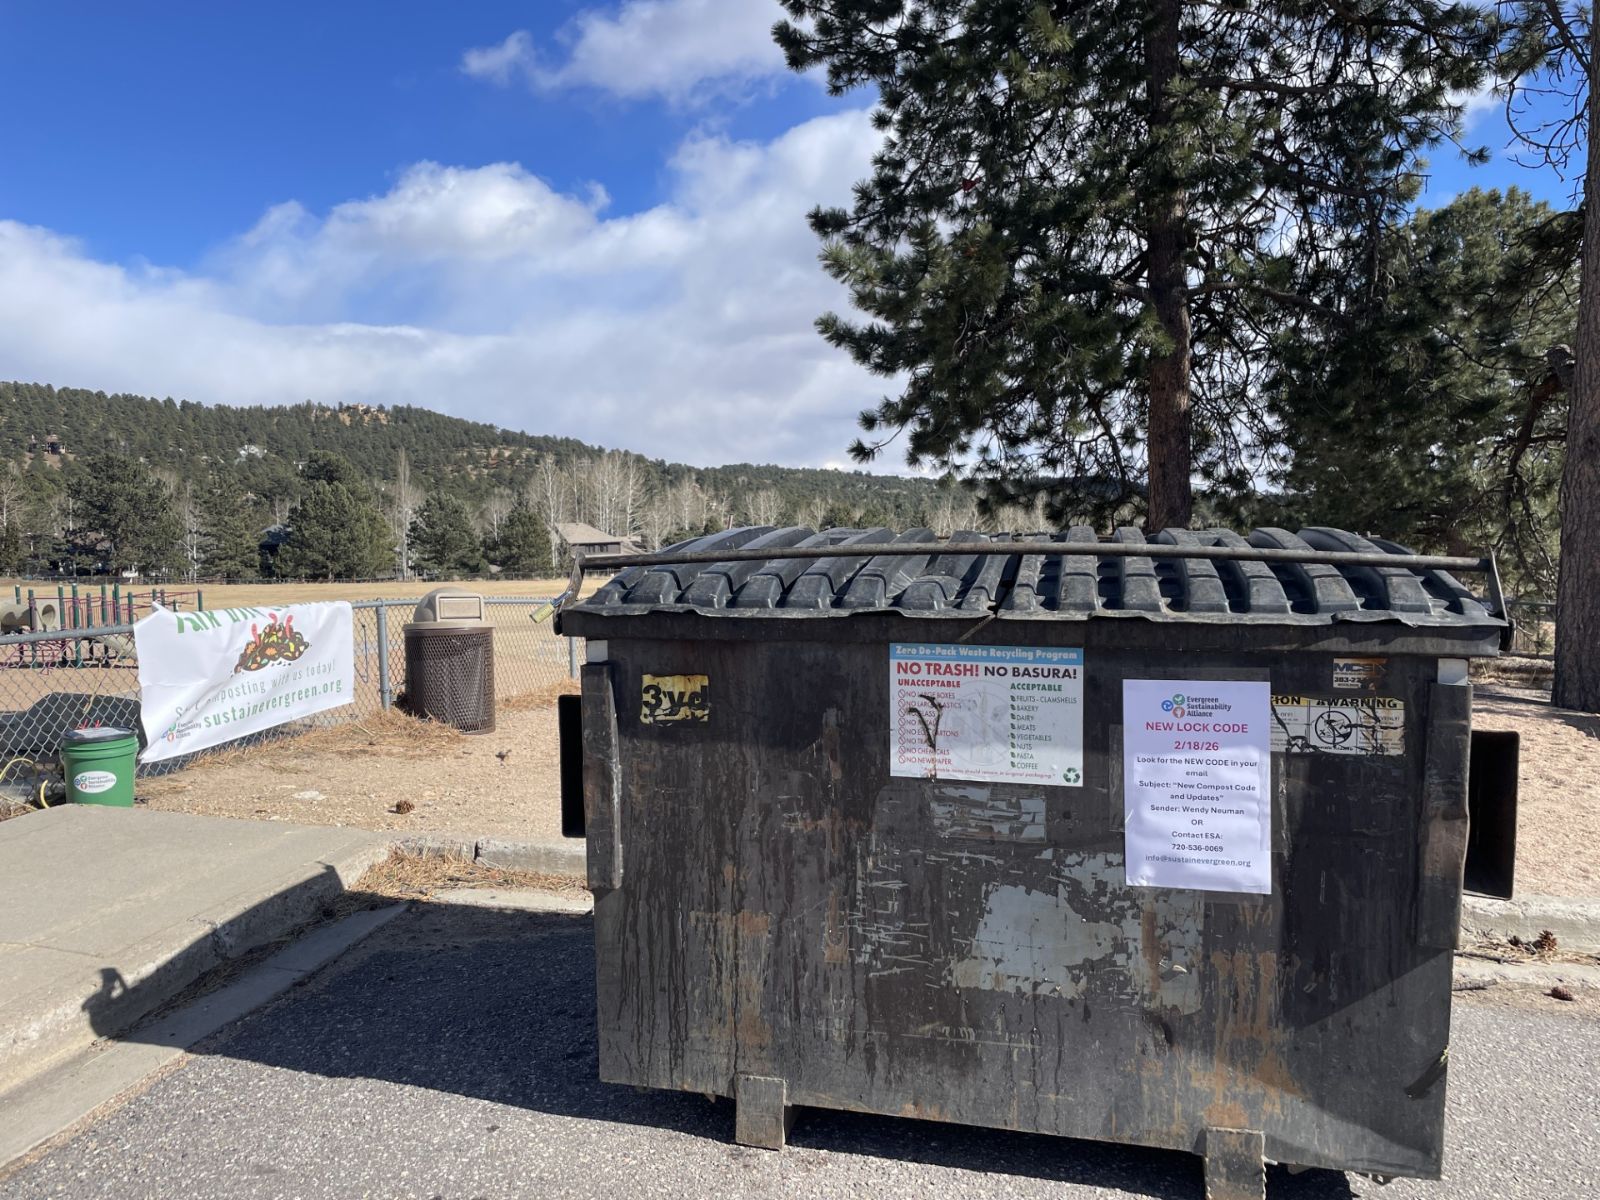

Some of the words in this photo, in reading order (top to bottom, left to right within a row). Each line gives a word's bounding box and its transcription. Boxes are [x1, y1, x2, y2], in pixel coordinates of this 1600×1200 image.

[896, 646, 917, 655] Zero
[959, 647, 987, 657] Waste
[990, 648, 1033, 661] Recycling
[1035, 650, 1077, 661] Program
[292, 669, 303, 681] us
[897, 662, 921, 675] NO
[925, 663, 979, 677] TRASH!
[985, 665, 1008, 677] NO
[1012, 667, 1077, 680] BASURA!
[898, 678, 961, 688] UNACCEPTABLE
[1010, 683, 1062, 692] ACCEPTABLE
[204, 679, 342, 729] sustainevergreen.org
[1187, 696, 1219, 705] Evergreen
[1187, 703, 1232, 712] Sustainability
[1187, 710, 1213, 718] Alliance
[1146, 721, 1173, 732] NEW
[1177, 723, 1210, 733] LOCK
[1213, 724, 1249, 734] CODE
[1017, 734, 1052, 742] VEGETABLES
[1174, 741, 1220, 751] 2/18/26
[1137, 756, 1156, 764] Look
[1017, 762, 1039, 770] COFFEE
[1139, 780, 1171, 789] Subject:
[1196, 782, 1233, 791] Compost
[1150, 804, 1180, 812] Sender:
[1182, 805, 1209, 814] Wendy
[1171, 831, 1203, 839] Contact
[1205, 832, 1223, 840] ESA:
[1145, 854, 1251, 868] info@sustainevergreen.org
